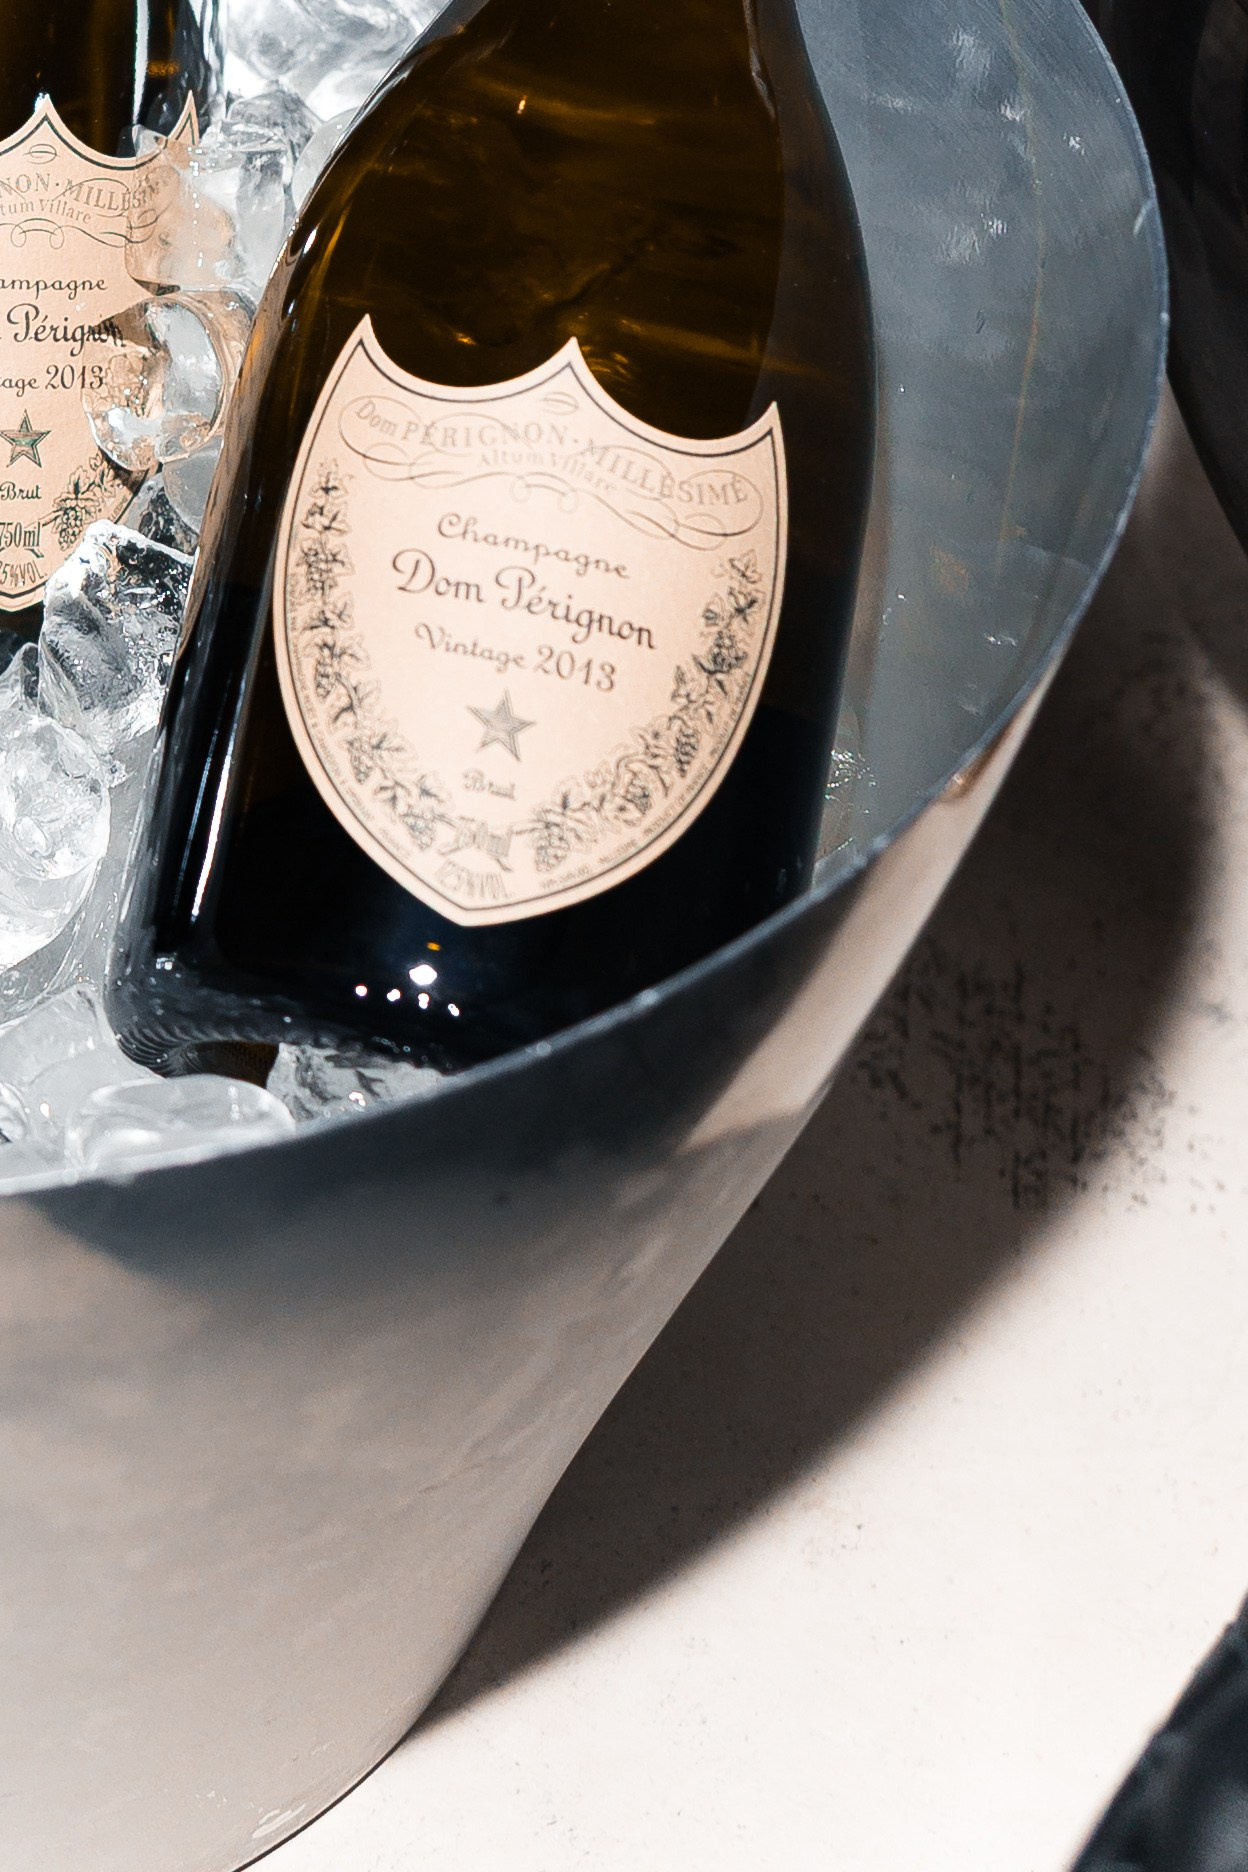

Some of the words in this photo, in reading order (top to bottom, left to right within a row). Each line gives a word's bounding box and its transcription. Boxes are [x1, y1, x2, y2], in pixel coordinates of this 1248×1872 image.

[39, 199, 92, 224] Villare
[45, 364, 103, 390] 2013
[355, 400, 397, 436] Dom
[0, 481, 42, 500] Brut
[438, 512, 631, 579] Champagne
[392, 548, 486, 603] Dom
[495, 565, 657, 650] Pérignon
[414, 622, 526, 674] Vintage
[534, 644, 616, 692] 2013
